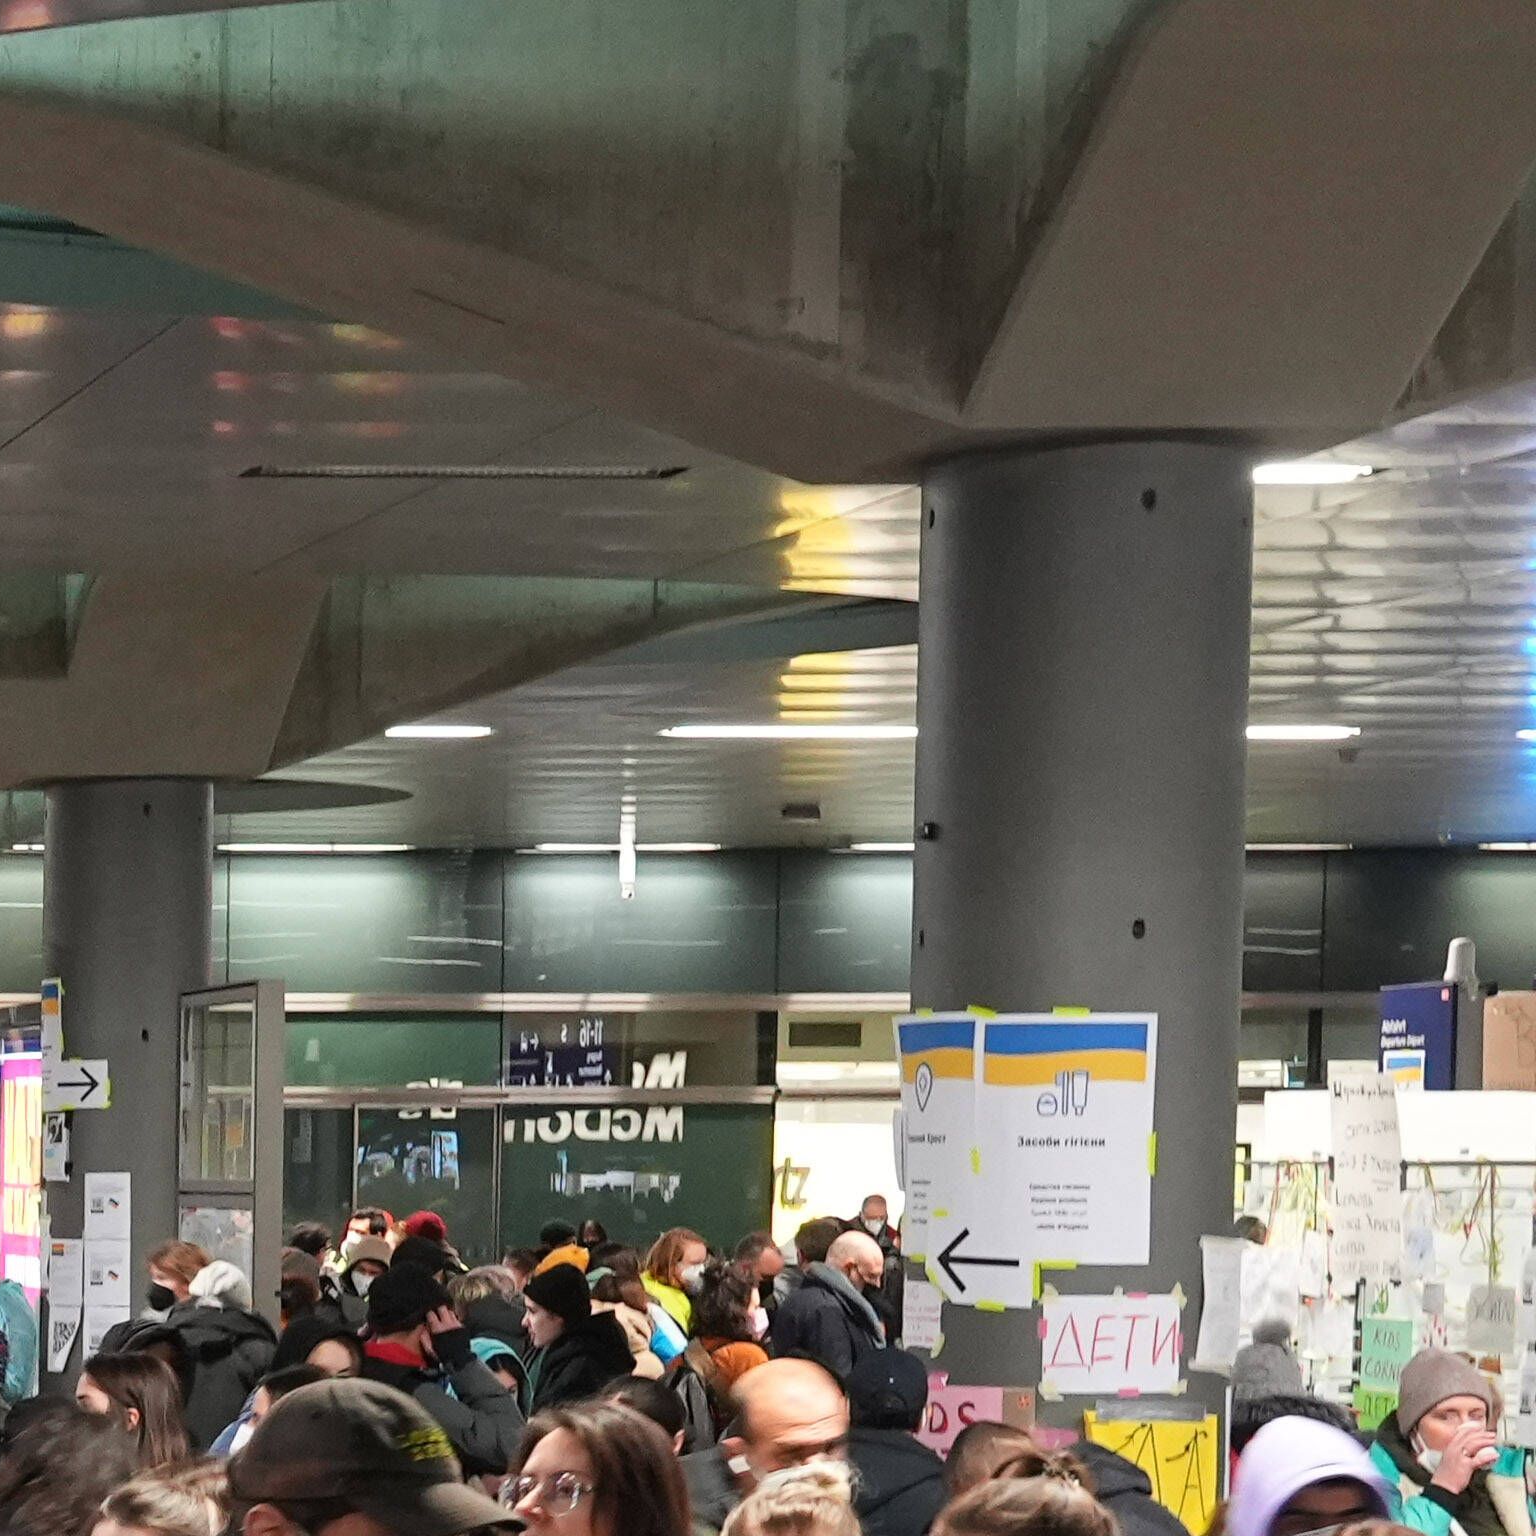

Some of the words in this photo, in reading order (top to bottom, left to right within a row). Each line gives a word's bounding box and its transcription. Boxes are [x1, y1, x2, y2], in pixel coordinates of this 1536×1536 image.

[1017, 1136, 1060, 1148] Засоби
[1043, 1312, 1178, 1373] ДЕТИ
[1373, 1327, 1401, 1351] KIDS
